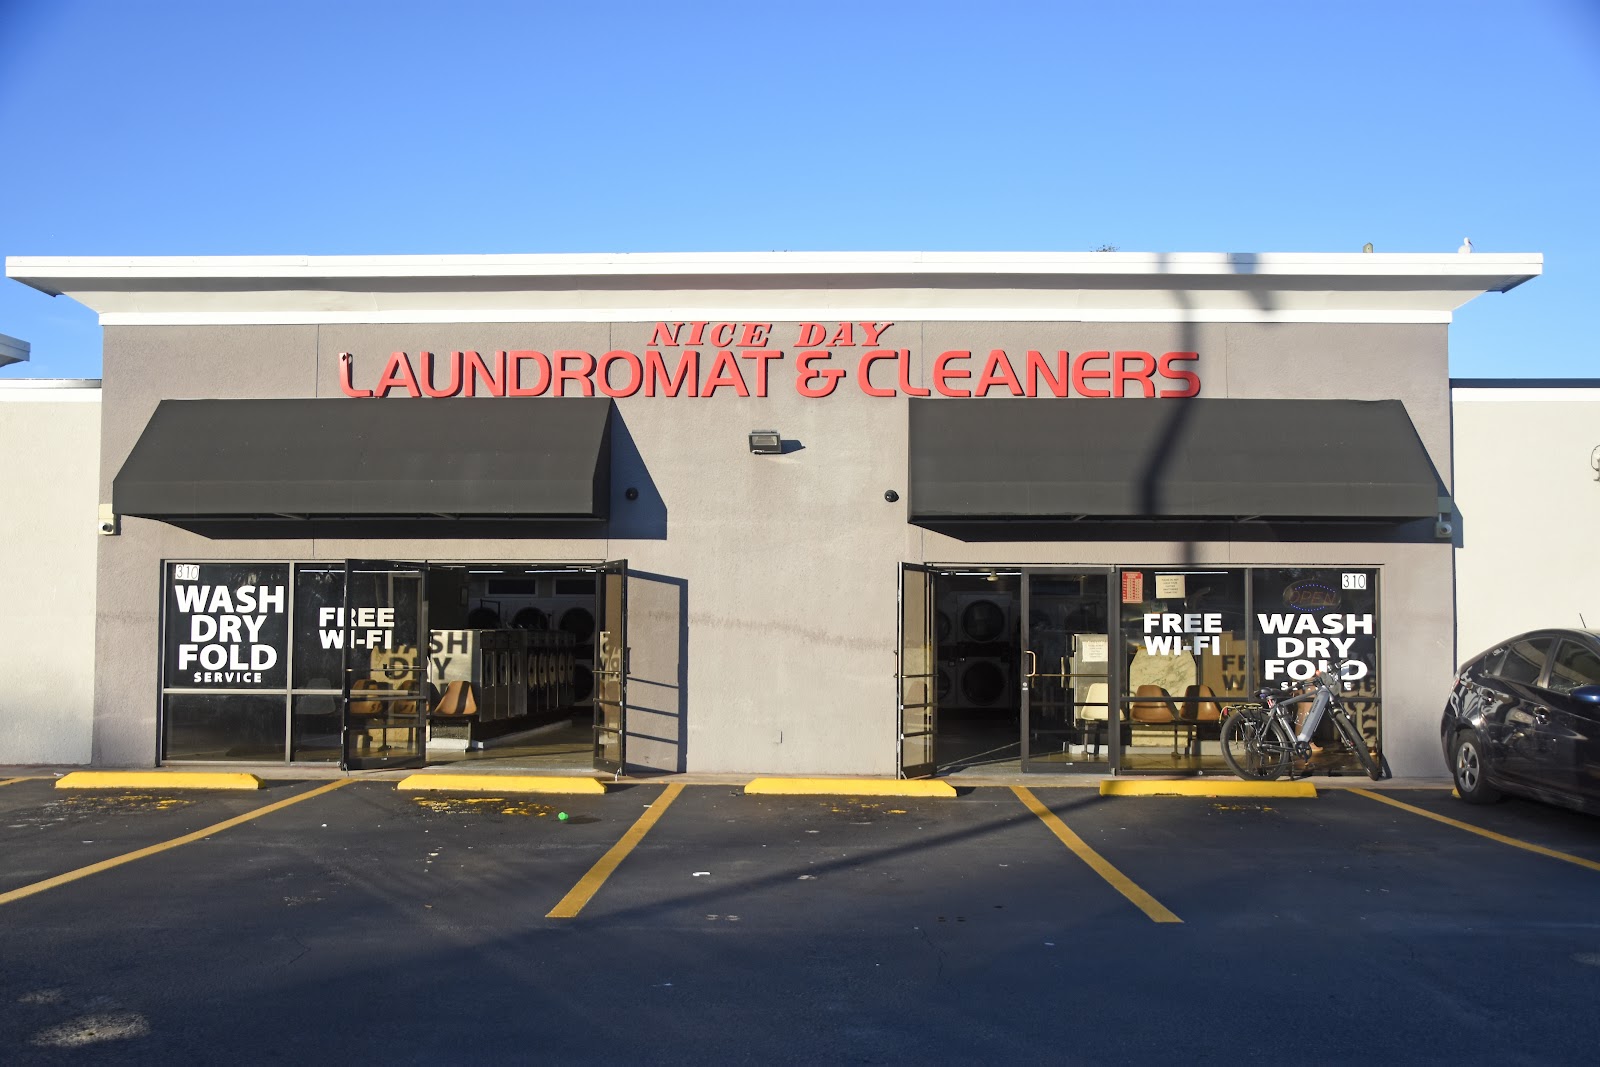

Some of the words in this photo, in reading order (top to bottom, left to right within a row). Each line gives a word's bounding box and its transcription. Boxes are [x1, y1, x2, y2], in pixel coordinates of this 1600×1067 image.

[647, 321, 772, 347] NICE
[794, 322, 894, 347] DAY
[339, 350, 783, 398] LAUNDROMAT
[795, 350, 846, 398] &
[857, 348, 1201, 398] CLEANERS
[176, 565, 199, 579] 310
[1343, 574, 1366, 589] 310
[174, 584, 285, 613] WASH
[1289, 590, 1336, 605] OPEN
[190, 614, 267, 642] DRY
[319, 607, 395, 628] FREE
[1143, 612, 1223, 634] FREE
[1257, 613, 1373, 635] WASH
[319, 630, 393, 650] WI-FI
[1143, 635, 1221, 656] WI-FI
[1277, 637, 1356, 659] DRY
[178, 643, 278, 671] FOLD
[193, 672, 262, 684] SERVICE
